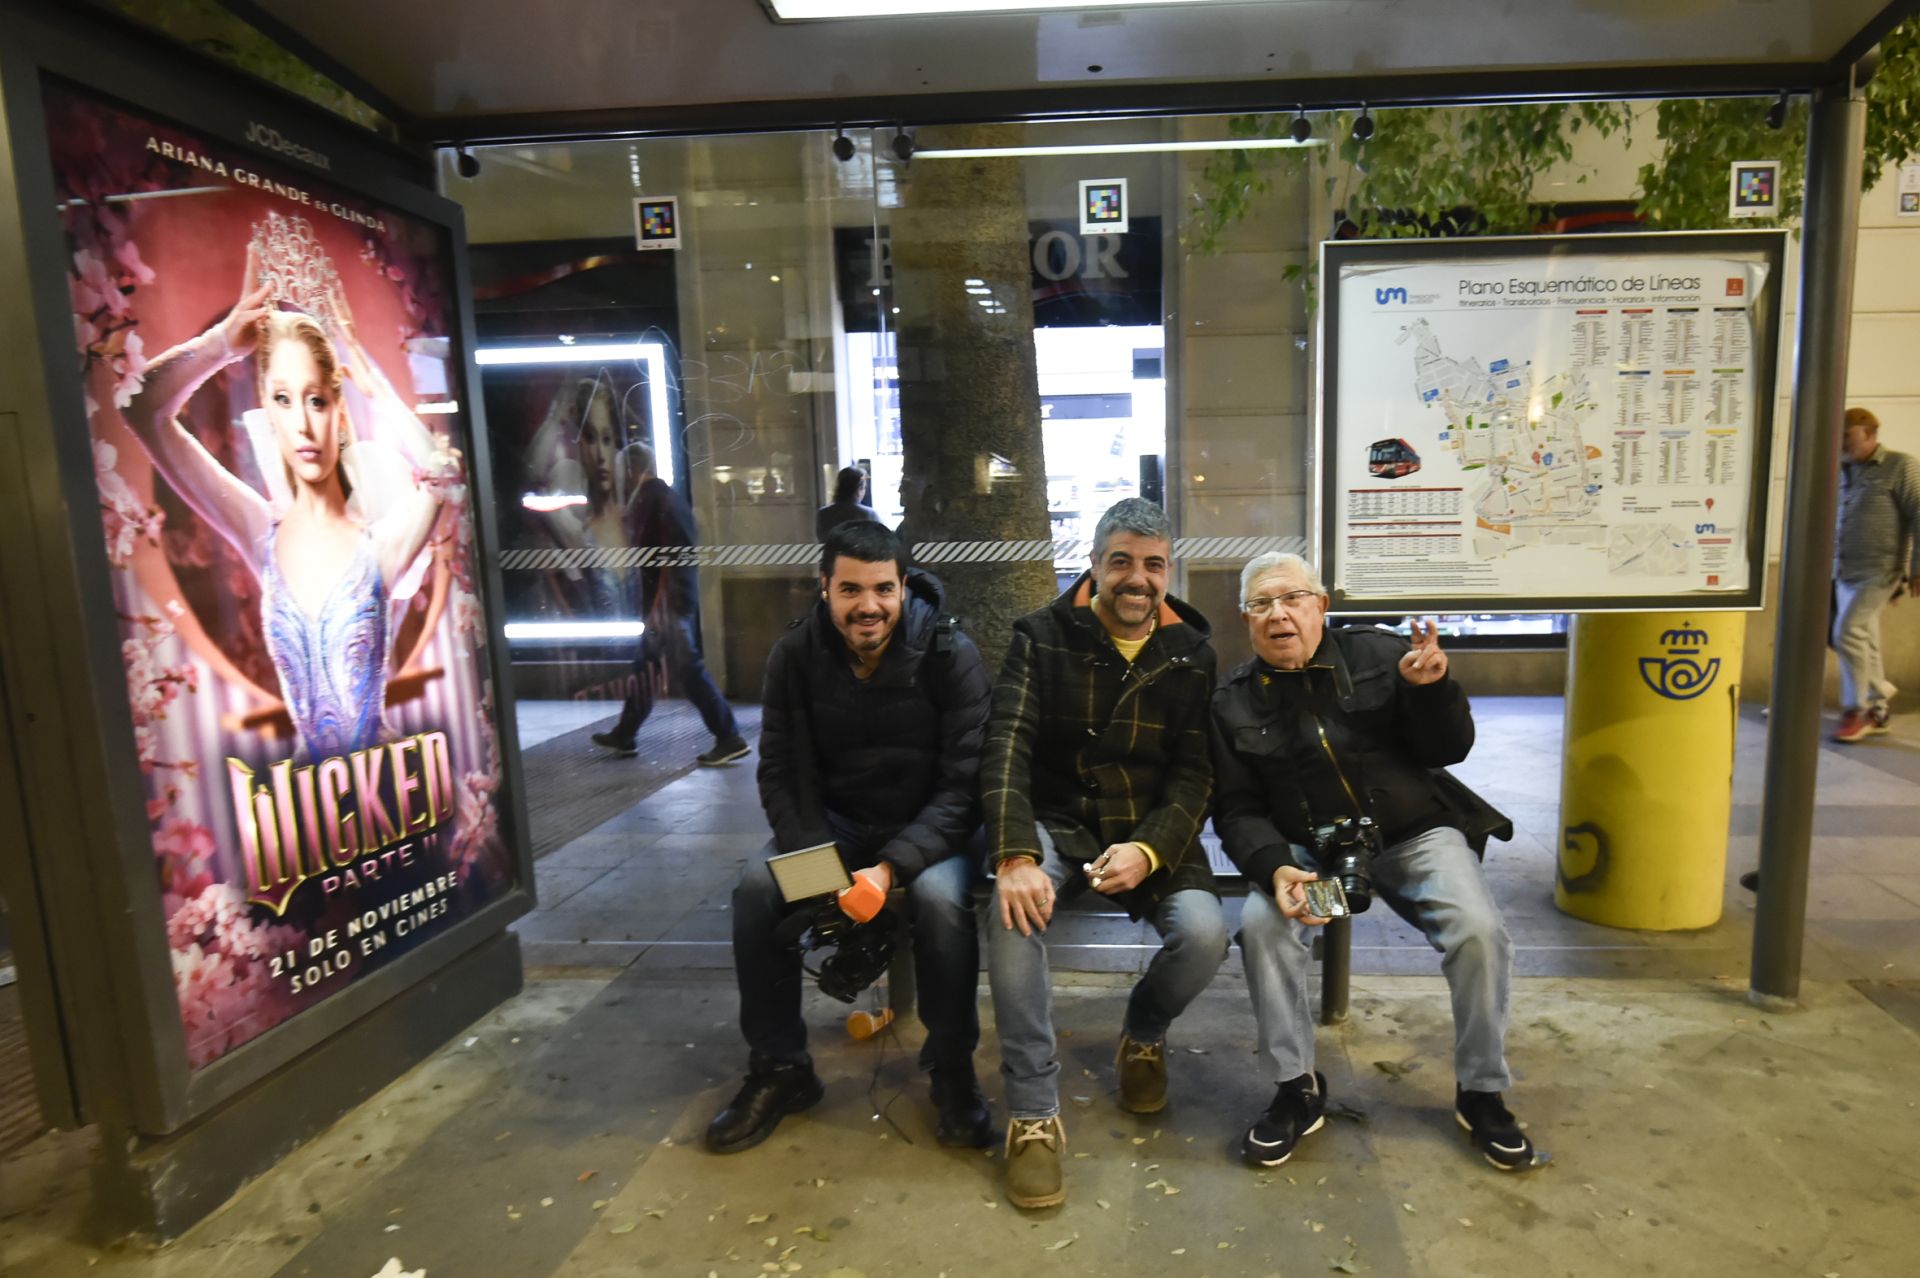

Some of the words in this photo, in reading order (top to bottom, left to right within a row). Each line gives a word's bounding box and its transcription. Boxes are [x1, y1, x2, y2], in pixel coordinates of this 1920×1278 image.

[145, 136, 228, 177] ARIANA
[233, 168, 311, 205] GRANDE
[330, 203, 386, 233] GLINDA
[245, 120, 331, 171] JCDecaux
[1458, 280, 1504, 295] Plano
[1508, 275, 1617, 296] Esquemático
[1621, 276, 1645, 292] de
[1649, 274, 1701, 291] Líneas
[225, 731, 455, 917] WICKED
[322, 843, 416, 895] PARTE
[269, 951, 296, 978] 21
[309, 930, 338, 957] DE
[347, 871, 458, 938] NOVIEMBRE
[290, 950, 352, 995] SOLO
[360, 931, 387, 956] EN
[395, 898, 448, 937] CINES
